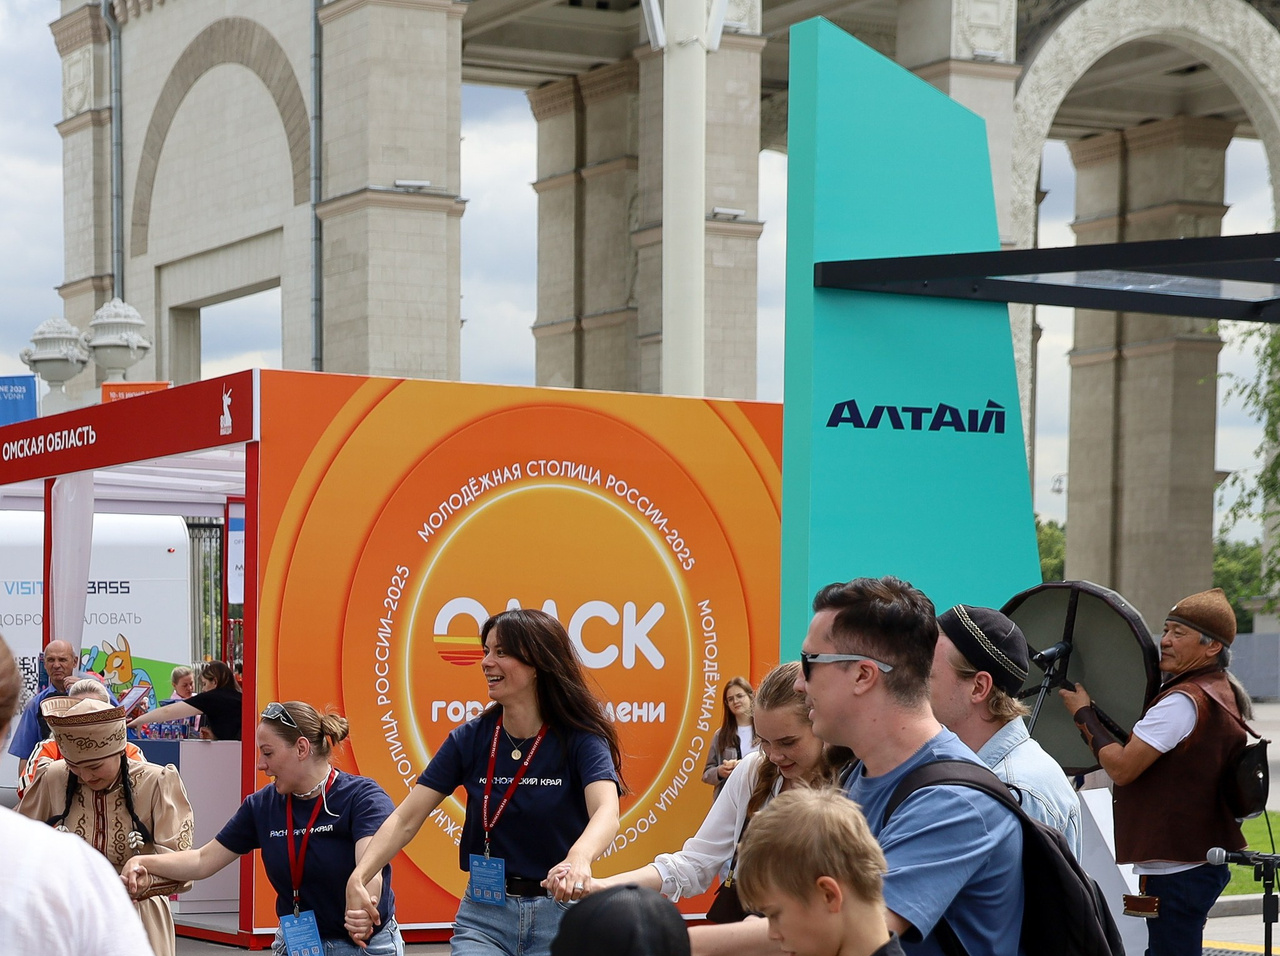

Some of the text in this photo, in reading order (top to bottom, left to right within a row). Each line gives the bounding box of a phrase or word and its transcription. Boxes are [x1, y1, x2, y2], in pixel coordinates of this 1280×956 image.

[10, 385, 27, 393] 2025
[825, 398, 1006, 434] АЛТАЙ
[2, 425, 97, 462] ОМСКАЯ ОБЛАСТЬ
[417, 459, 697, 571] МОЛОДЁЖНАЯ СТОЛИЦА РОССИИ-2025
[86, 581, 130, 594] BASS
[432, 596, 666, 670] ОСК
[375, 564, 417, 793] ТОЛИЦА РОССИИ-2025
[696, 598, 721, 732] МОЛОДЁЖНАЯ
[540, 778, 562, 786] КРАЙ
[655, 735, 704, 812] СТОЛИЦА
